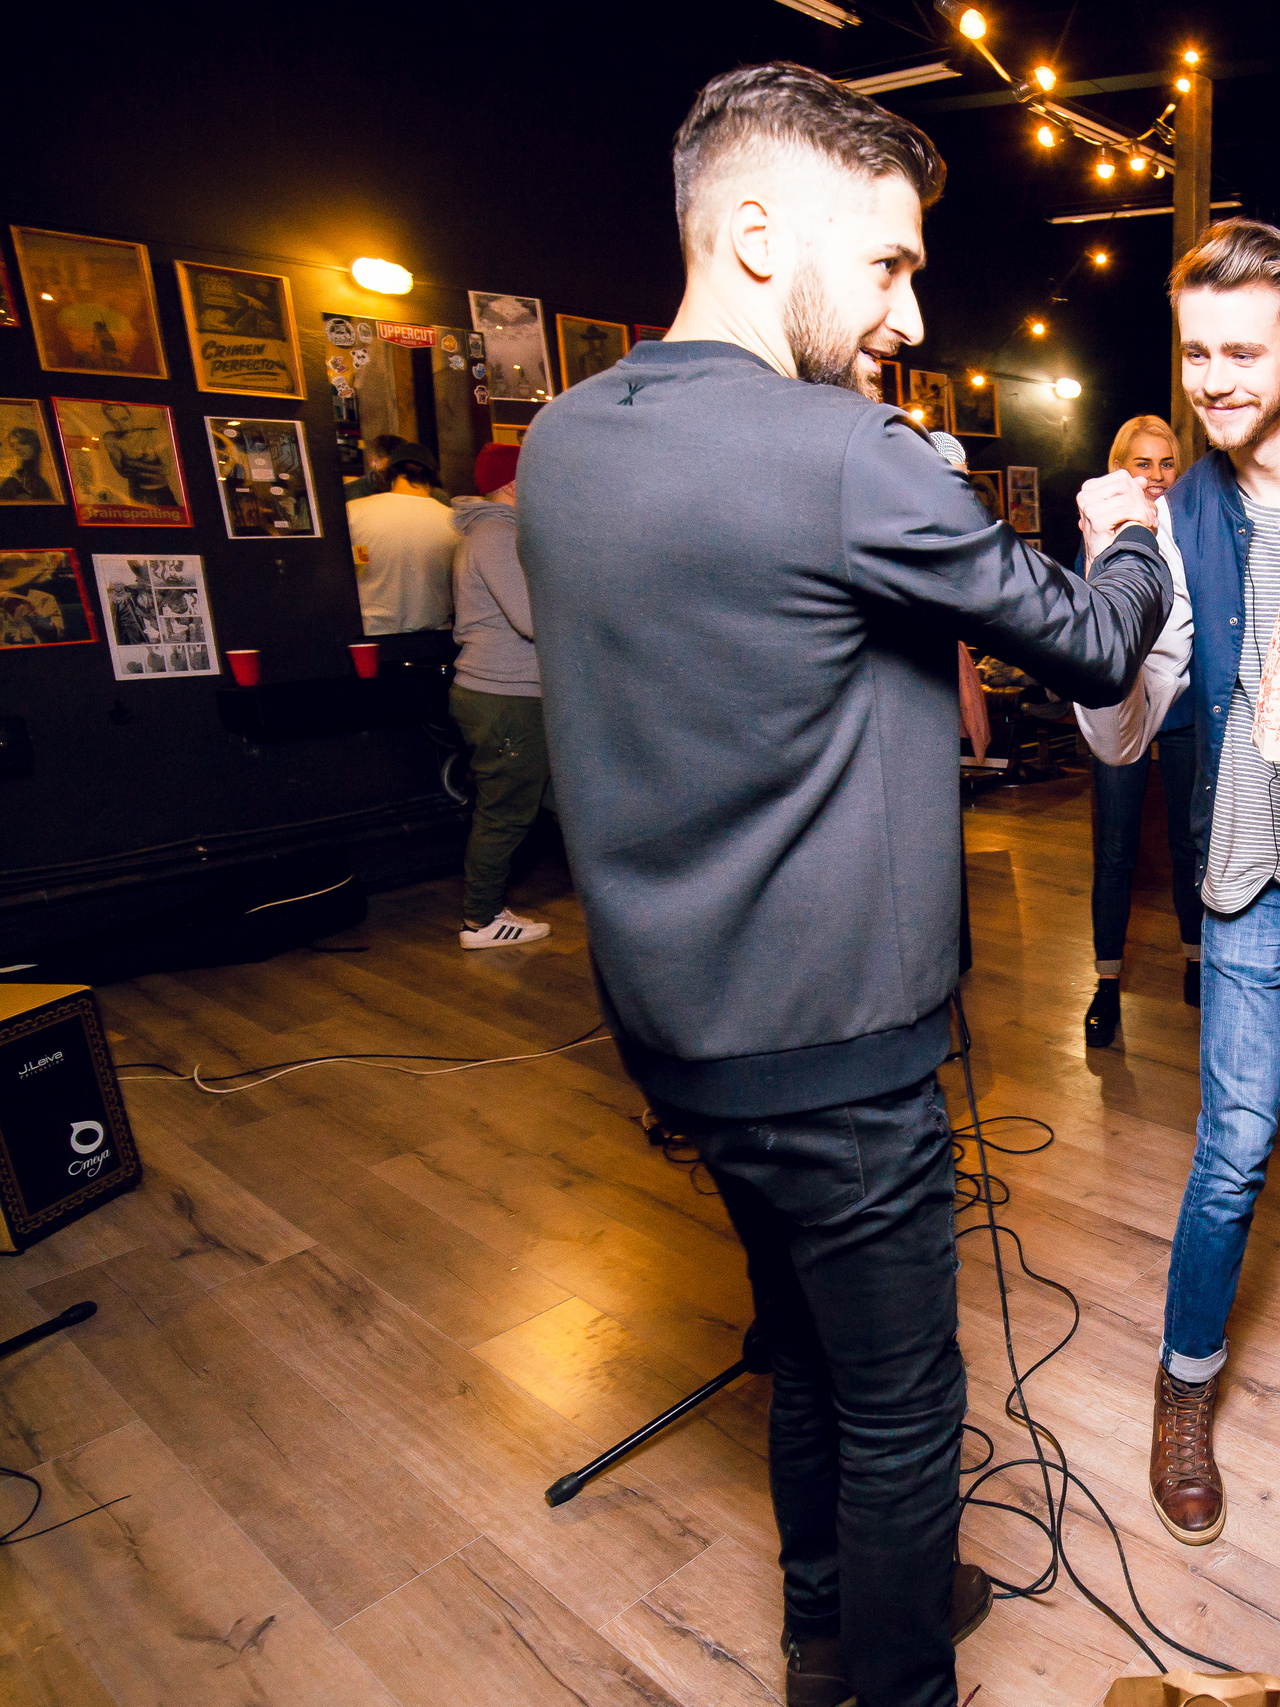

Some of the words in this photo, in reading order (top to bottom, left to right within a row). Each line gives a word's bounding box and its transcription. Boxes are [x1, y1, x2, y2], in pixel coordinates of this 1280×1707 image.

[379, 323, 434, 345] UPPERCUT
[201, 340, 267, 361] CRIMEN
[210, 358, 276, 377] PERFECTO
[84, 506, 181, 522] Trainspotting
[18, 1051, 63, 1075] J.Leiva
